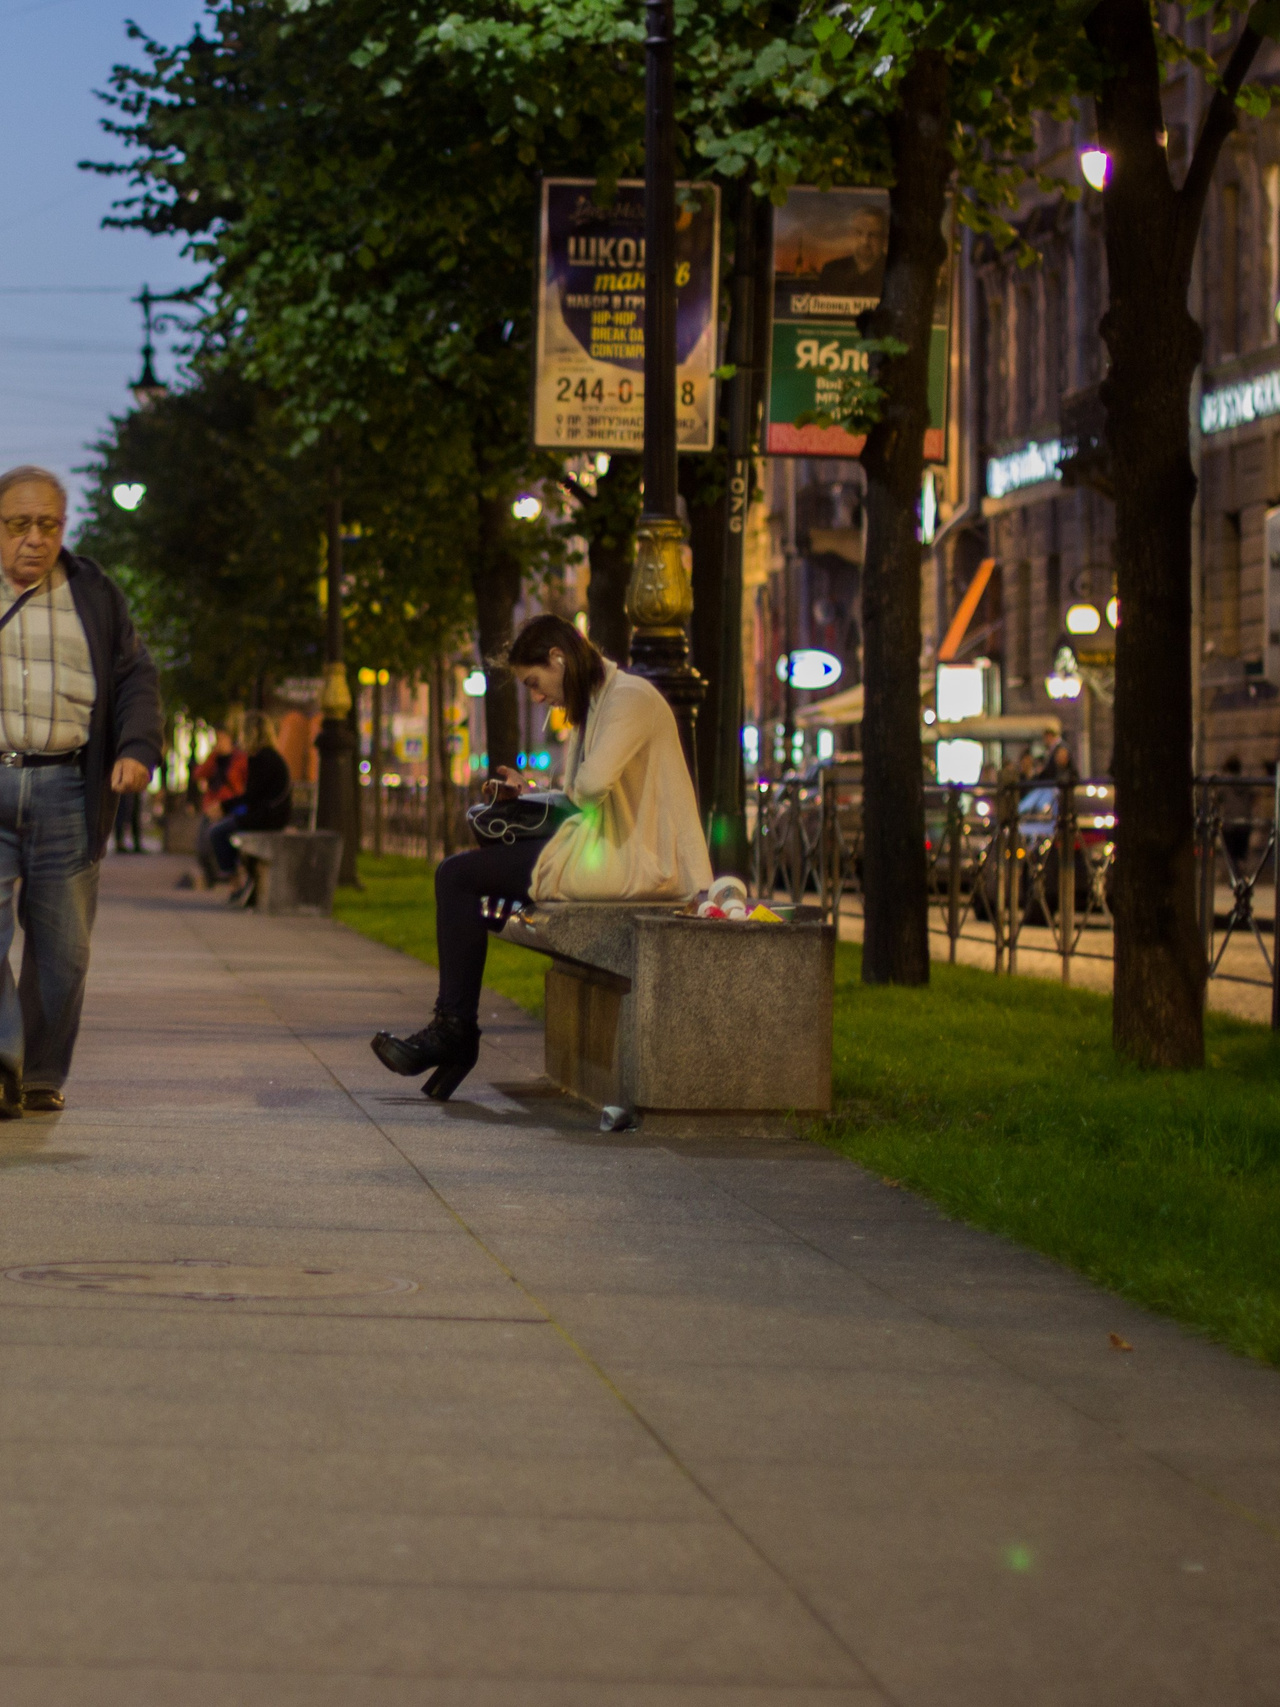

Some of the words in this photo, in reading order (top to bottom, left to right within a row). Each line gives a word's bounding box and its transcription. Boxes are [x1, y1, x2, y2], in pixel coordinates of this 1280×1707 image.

[568, 236, 646, 268] ШКО
[592, 310, 637, 326] HIP-HOP
[592, 326, 627, 342] BREAK
[592, 342, 646, 359] CONTEMP
[795, 339, 870, 373] Ябл
